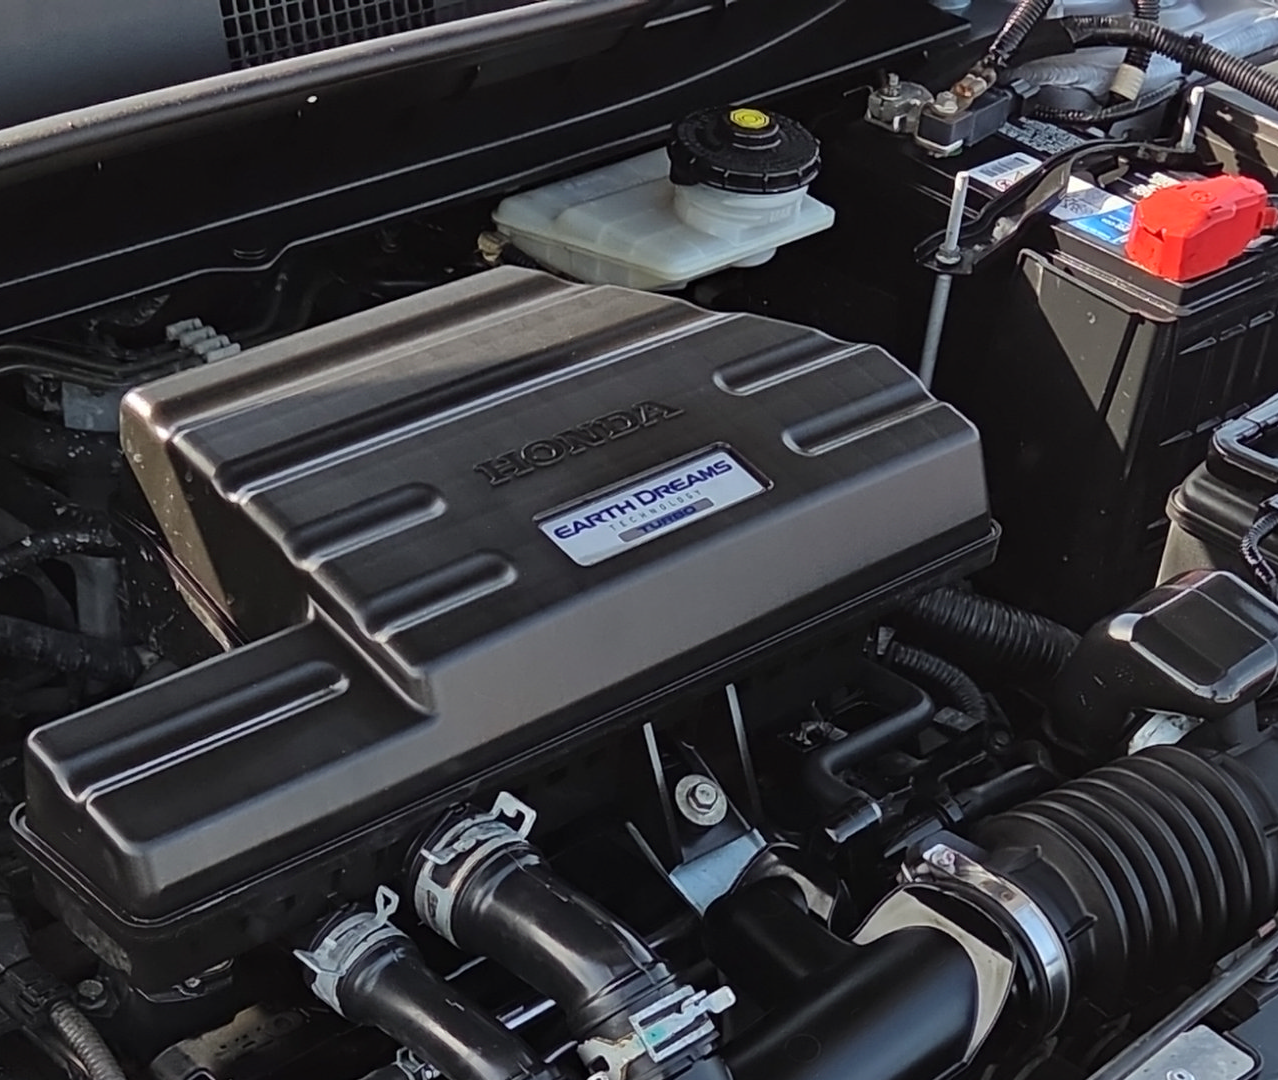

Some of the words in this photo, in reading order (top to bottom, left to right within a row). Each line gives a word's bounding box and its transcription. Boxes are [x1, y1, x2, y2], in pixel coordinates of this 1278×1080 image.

[473, 401, 684, 485] HONDA
[553, 500, 636, 540] EARTH
[632, 460, 733, 506] DREAMS
[609, 489, 702, 532] TECHNOLOGY
[638, 505, 698, 534] TURBO
